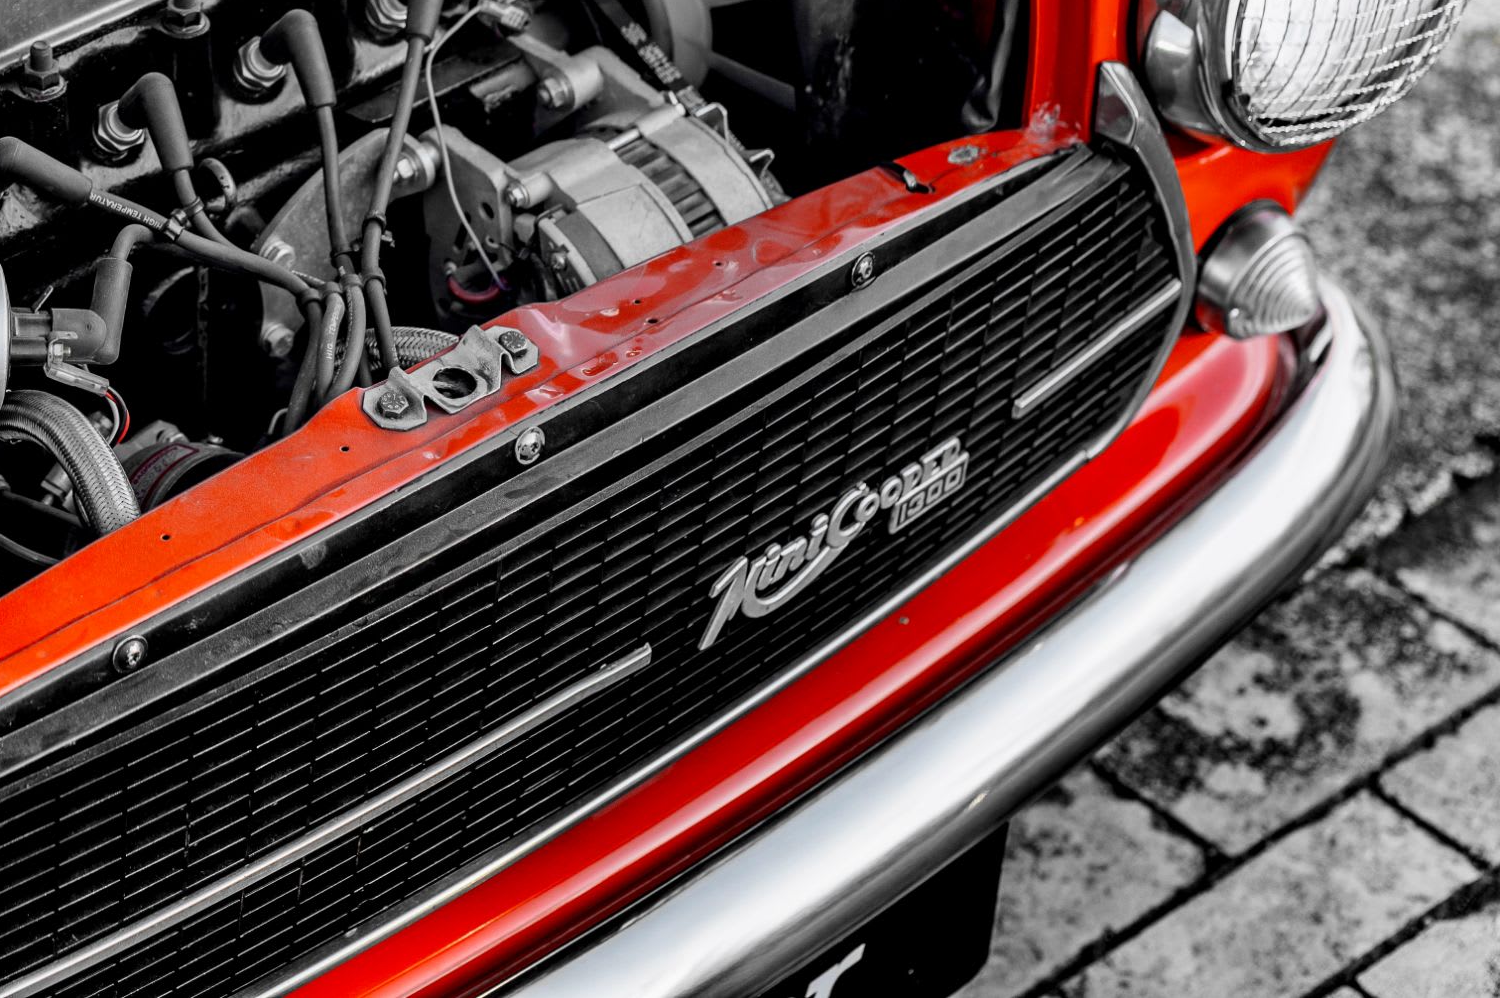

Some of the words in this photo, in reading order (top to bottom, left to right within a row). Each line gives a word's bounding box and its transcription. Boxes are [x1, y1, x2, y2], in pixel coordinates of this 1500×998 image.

[89, 192, 142, 220] TEMPERATUR
[143, 214, 163, 231] HIGH
[899, 465, 963, 525] 1300
